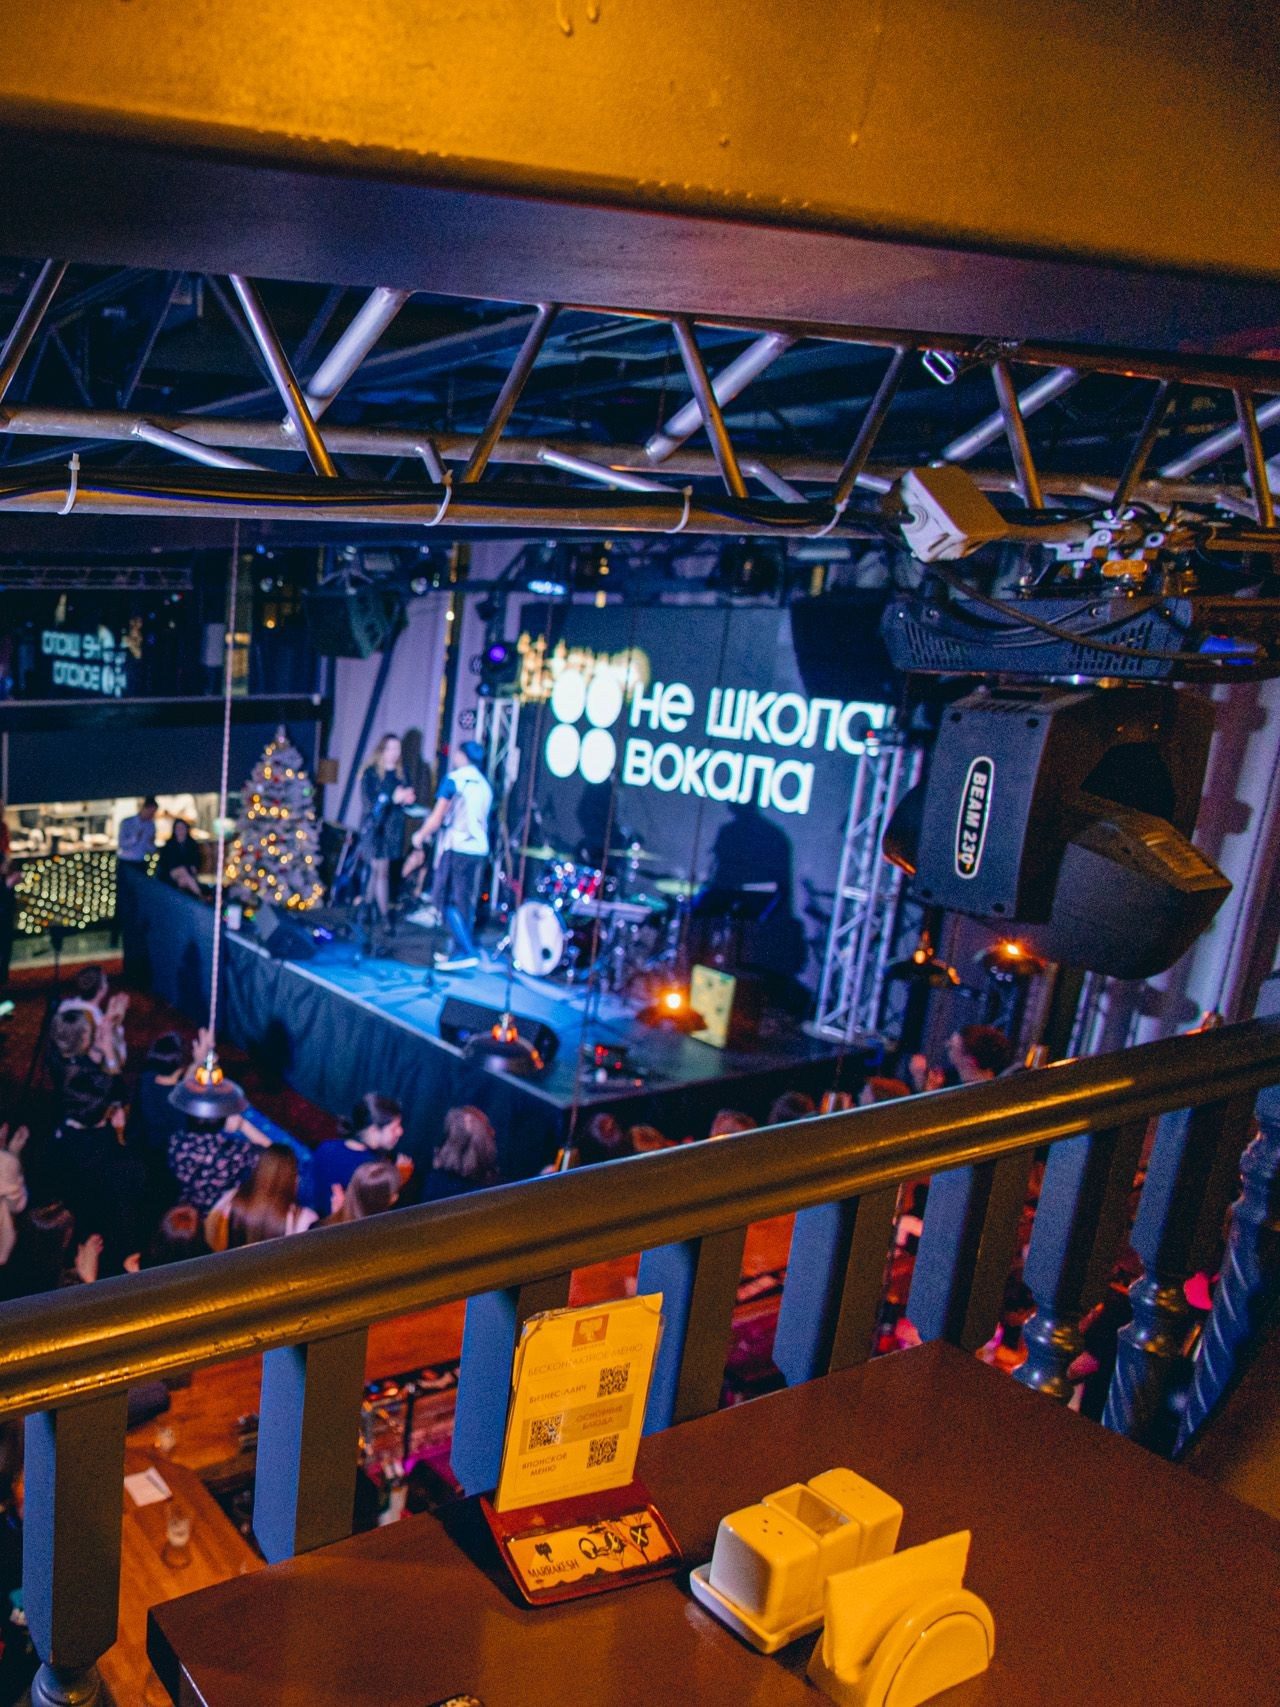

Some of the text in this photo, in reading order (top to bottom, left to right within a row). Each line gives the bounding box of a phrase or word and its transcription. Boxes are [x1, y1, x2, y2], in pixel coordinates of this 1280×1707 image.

[960, 771, 988, 865] BEAM 230
[530, 1465, 557, 1477] МЕНЮ
[527, 1558, 580, 1578] MARRAKESH
